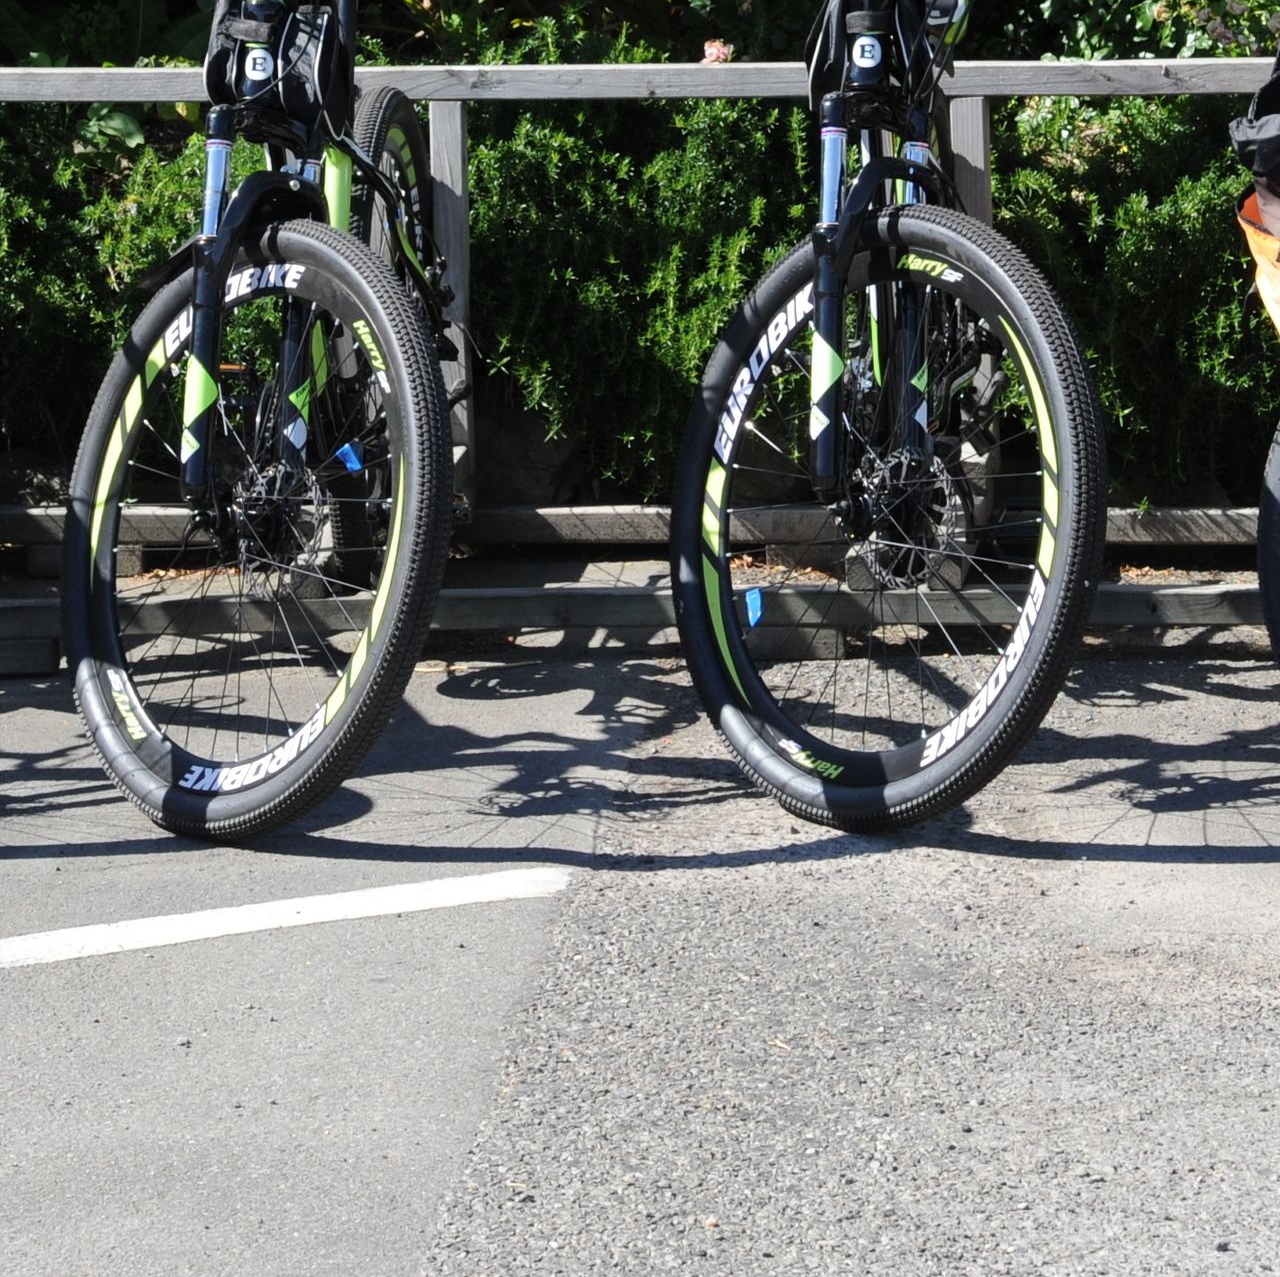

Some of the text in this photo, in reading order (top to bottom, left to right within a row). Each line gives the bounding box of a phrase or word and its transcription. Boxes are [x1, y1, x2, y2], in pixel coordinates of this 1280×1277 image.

[251, 56, 266, 71] E
[860, 44, 875, 59] E
[896, 254, 951, 277] Harry
[352, 319, 387, 371] Harry
[713, 281, 815, 465] EUROBIK
[920, 568, 1047, 768] EUROBIKE
[178, 702, 327, 792] EUROBIKE
[793, 750, 844, 779] Harry
